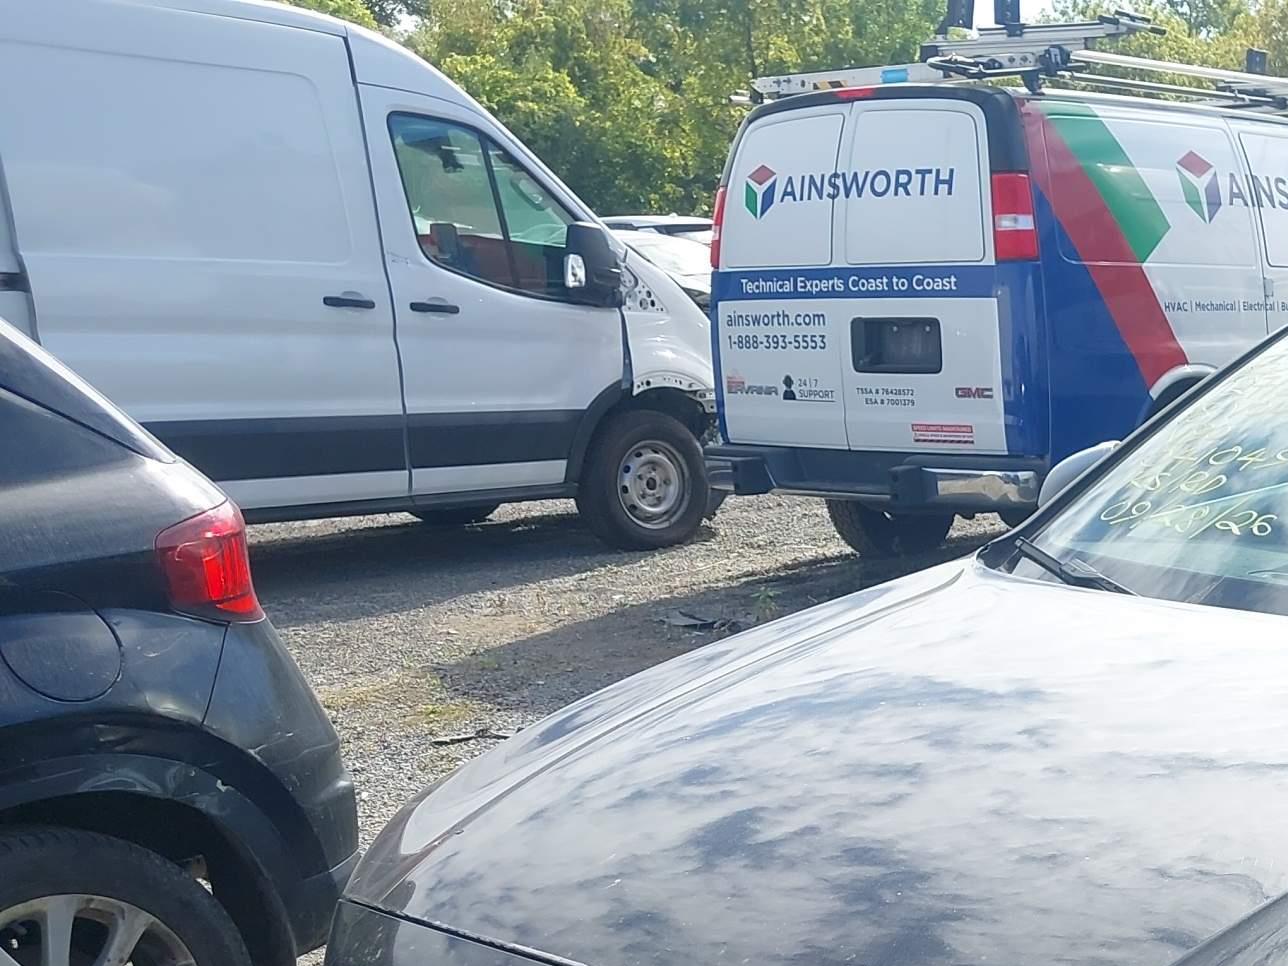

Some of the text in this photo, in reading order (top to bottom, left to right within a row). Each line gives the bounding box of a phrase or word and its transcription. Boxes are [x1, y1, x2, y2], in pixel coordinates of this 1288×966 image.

[780, 168, 956, 203] AINSWORTH
[740, 274, 957, 295] Technical Experts Coast to Coast
[1164, 301, 1188, 312] HVAC
[1195, 301, 1237, 312] Mechanical
[1242, 301, 1276, 312] Electrical
[726, 309, 827, 328] ainsworth.com
[728, 334, 827, 351] 1-888-393-5553
[799, 390, 835, 399] SUPPORT
[955, 387, 994, 399] GMC
